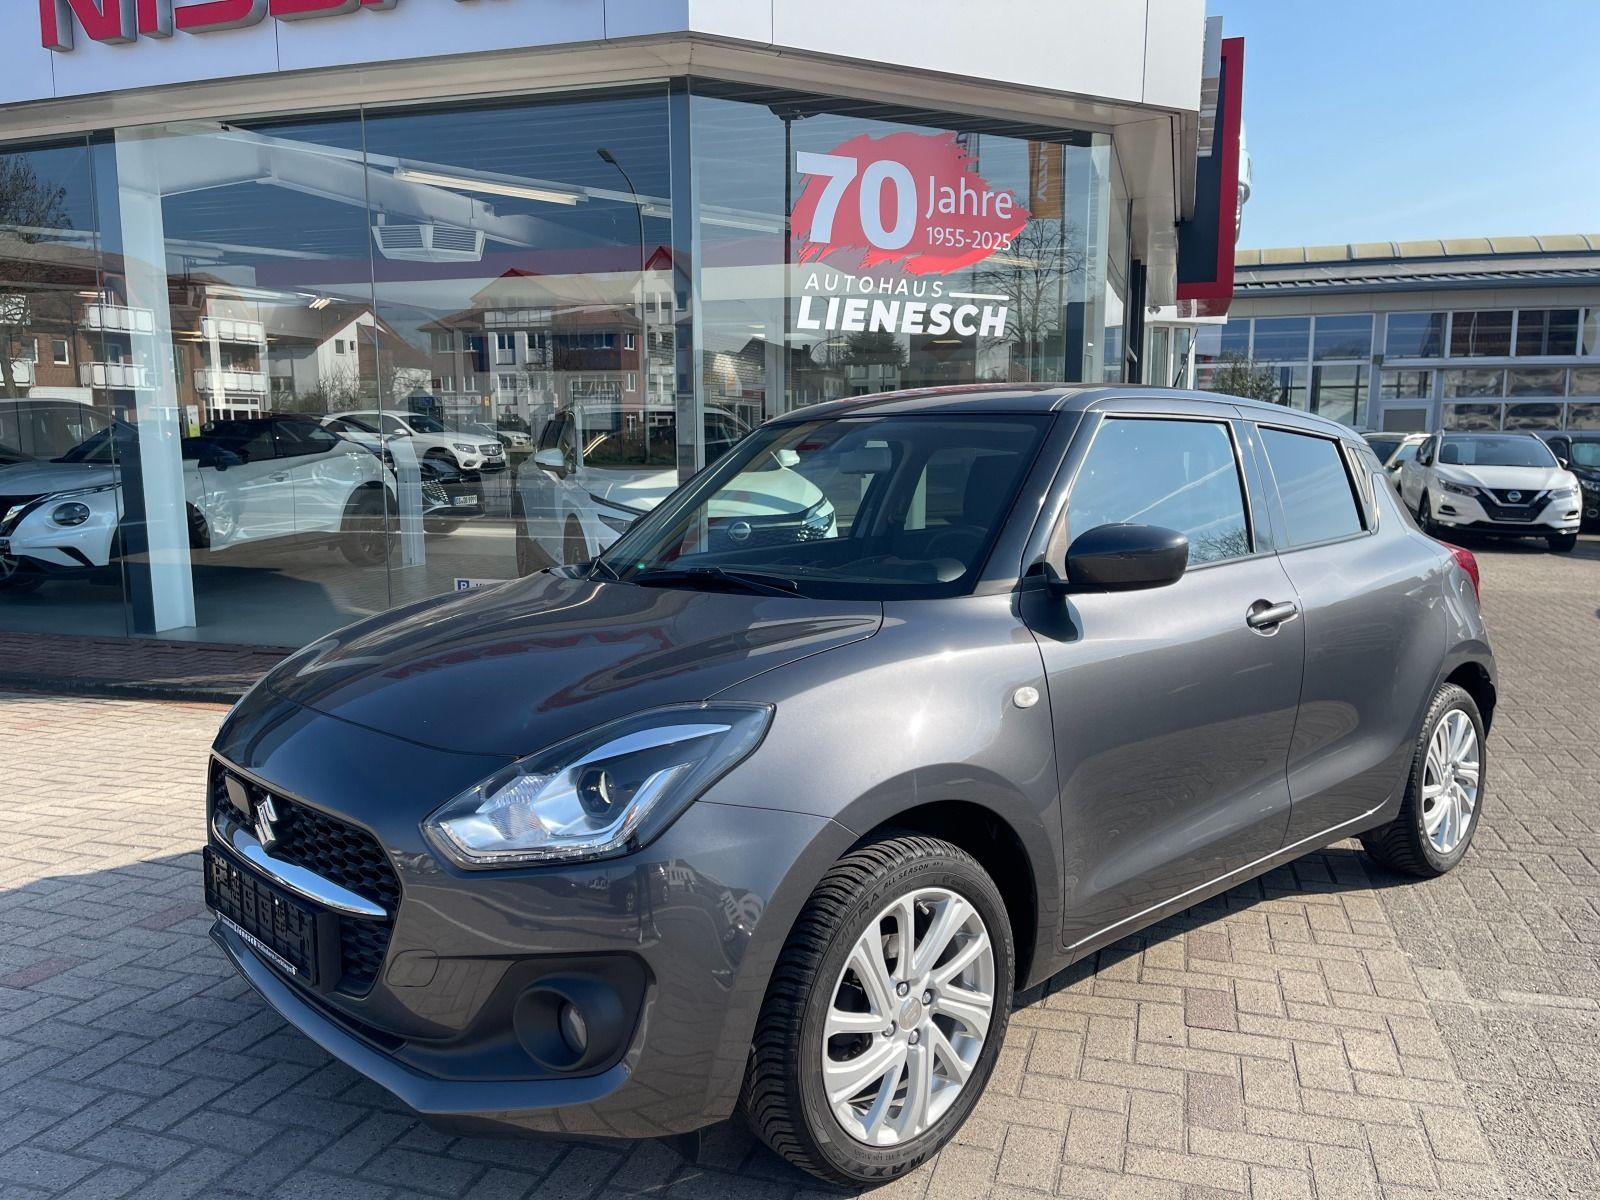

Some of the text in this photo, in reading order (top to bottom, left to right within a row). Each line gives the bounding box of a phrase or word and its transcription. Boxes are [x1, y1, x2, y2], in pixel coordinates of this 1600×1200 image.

[797, 151, 917, 250] 70
[925, 176, 1012, 219] Jahre
[926, 226, 1012, 251] 1955-2025
[804, 272, 944, 298] AUTOHAUS
[797, 295, 1008, 338] LIENESCH
[898, 863, 929, 879] SEASON
